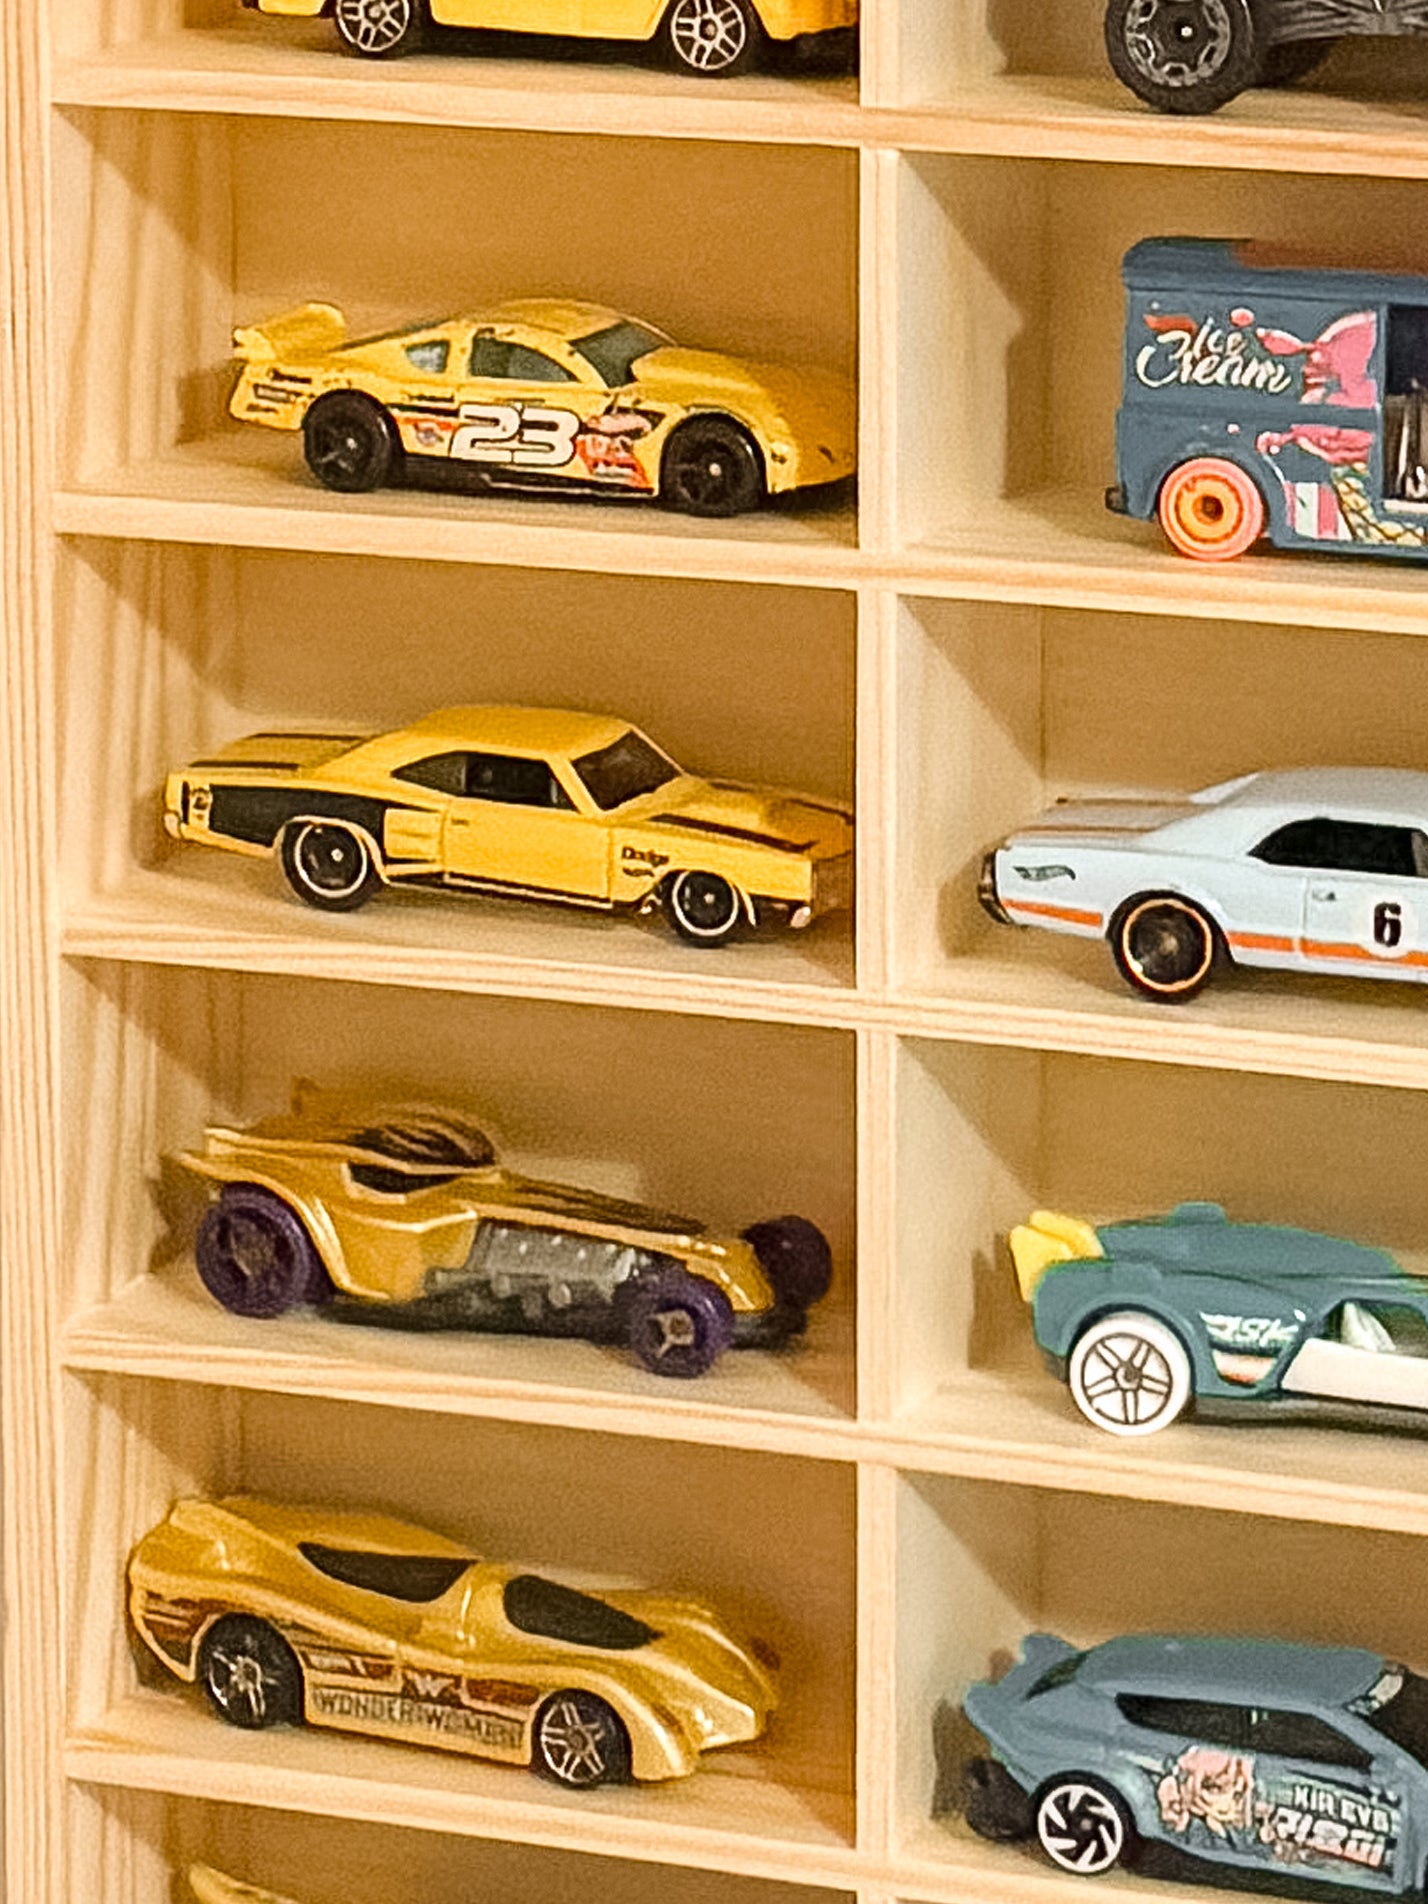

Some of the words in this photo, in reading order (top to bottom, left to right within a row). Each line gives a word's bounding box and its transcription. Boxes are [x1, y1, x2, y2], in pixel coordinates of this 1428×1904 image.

[448, 403, 581, 468] 23
[1373, 901, 1402, 948] 6
[313, 1689, 415, 1722] WONDER
